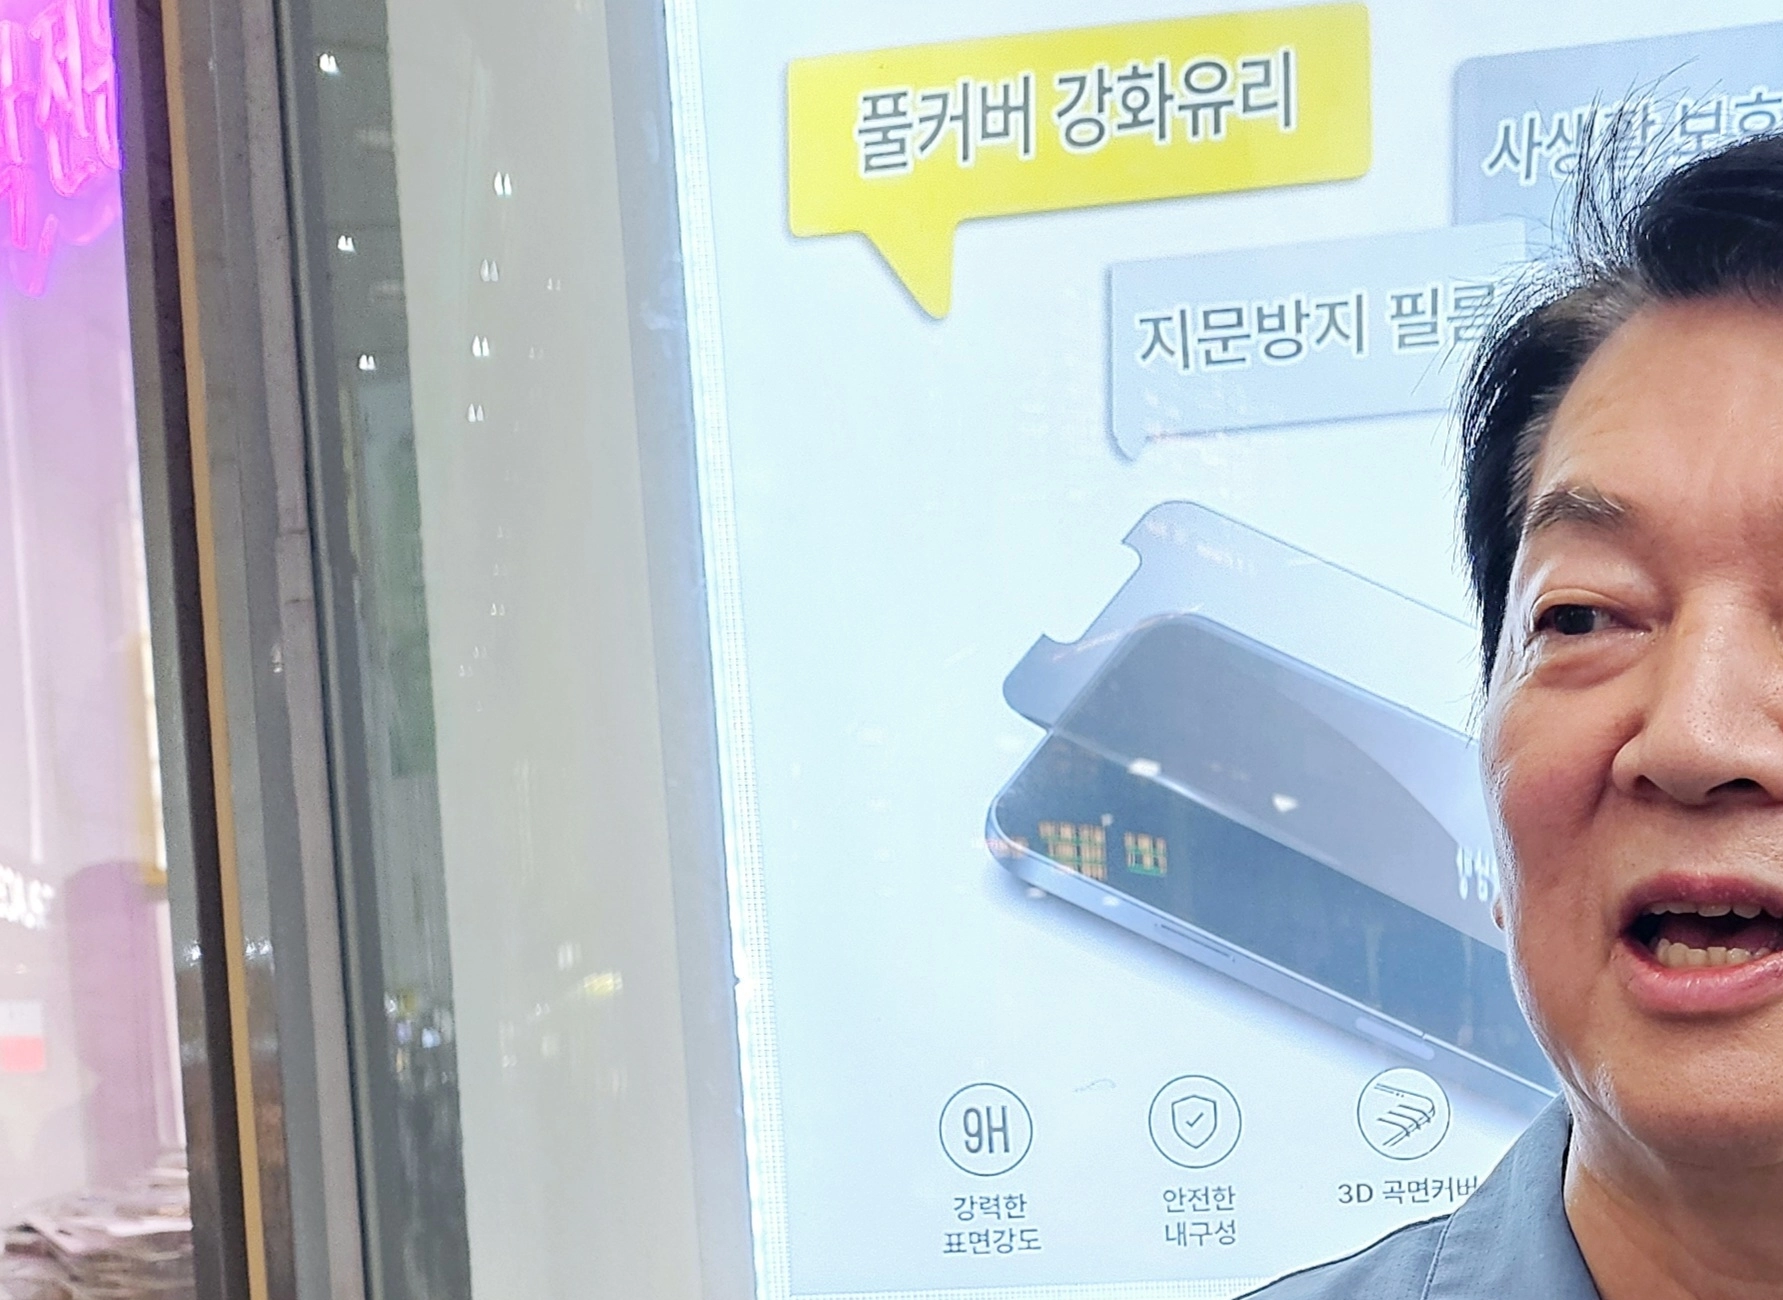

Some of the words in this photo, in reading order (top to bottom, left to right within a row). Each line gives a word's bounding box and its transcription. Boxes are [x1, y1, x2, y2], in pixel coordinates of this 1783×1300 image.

[856, 75, 1033, 175] 풀커버
[1056, 49, 1294, 150] 강화유리
[1139, 295, 1366, 369] 지문방지
[962, 1104, 1011, 1154] 9H
[1163, 1185, 1237, 1214] 안전한
[1337, 1182, 1374, 1205] 3D
[1382, 1175, 1479, 1204] 곡면커버
[953, 1194, 1027, 1221] 강력한
[942, 1228, 1042, 1256] 표면강도
[1164, 1218, 1237, 1248] 내구성
